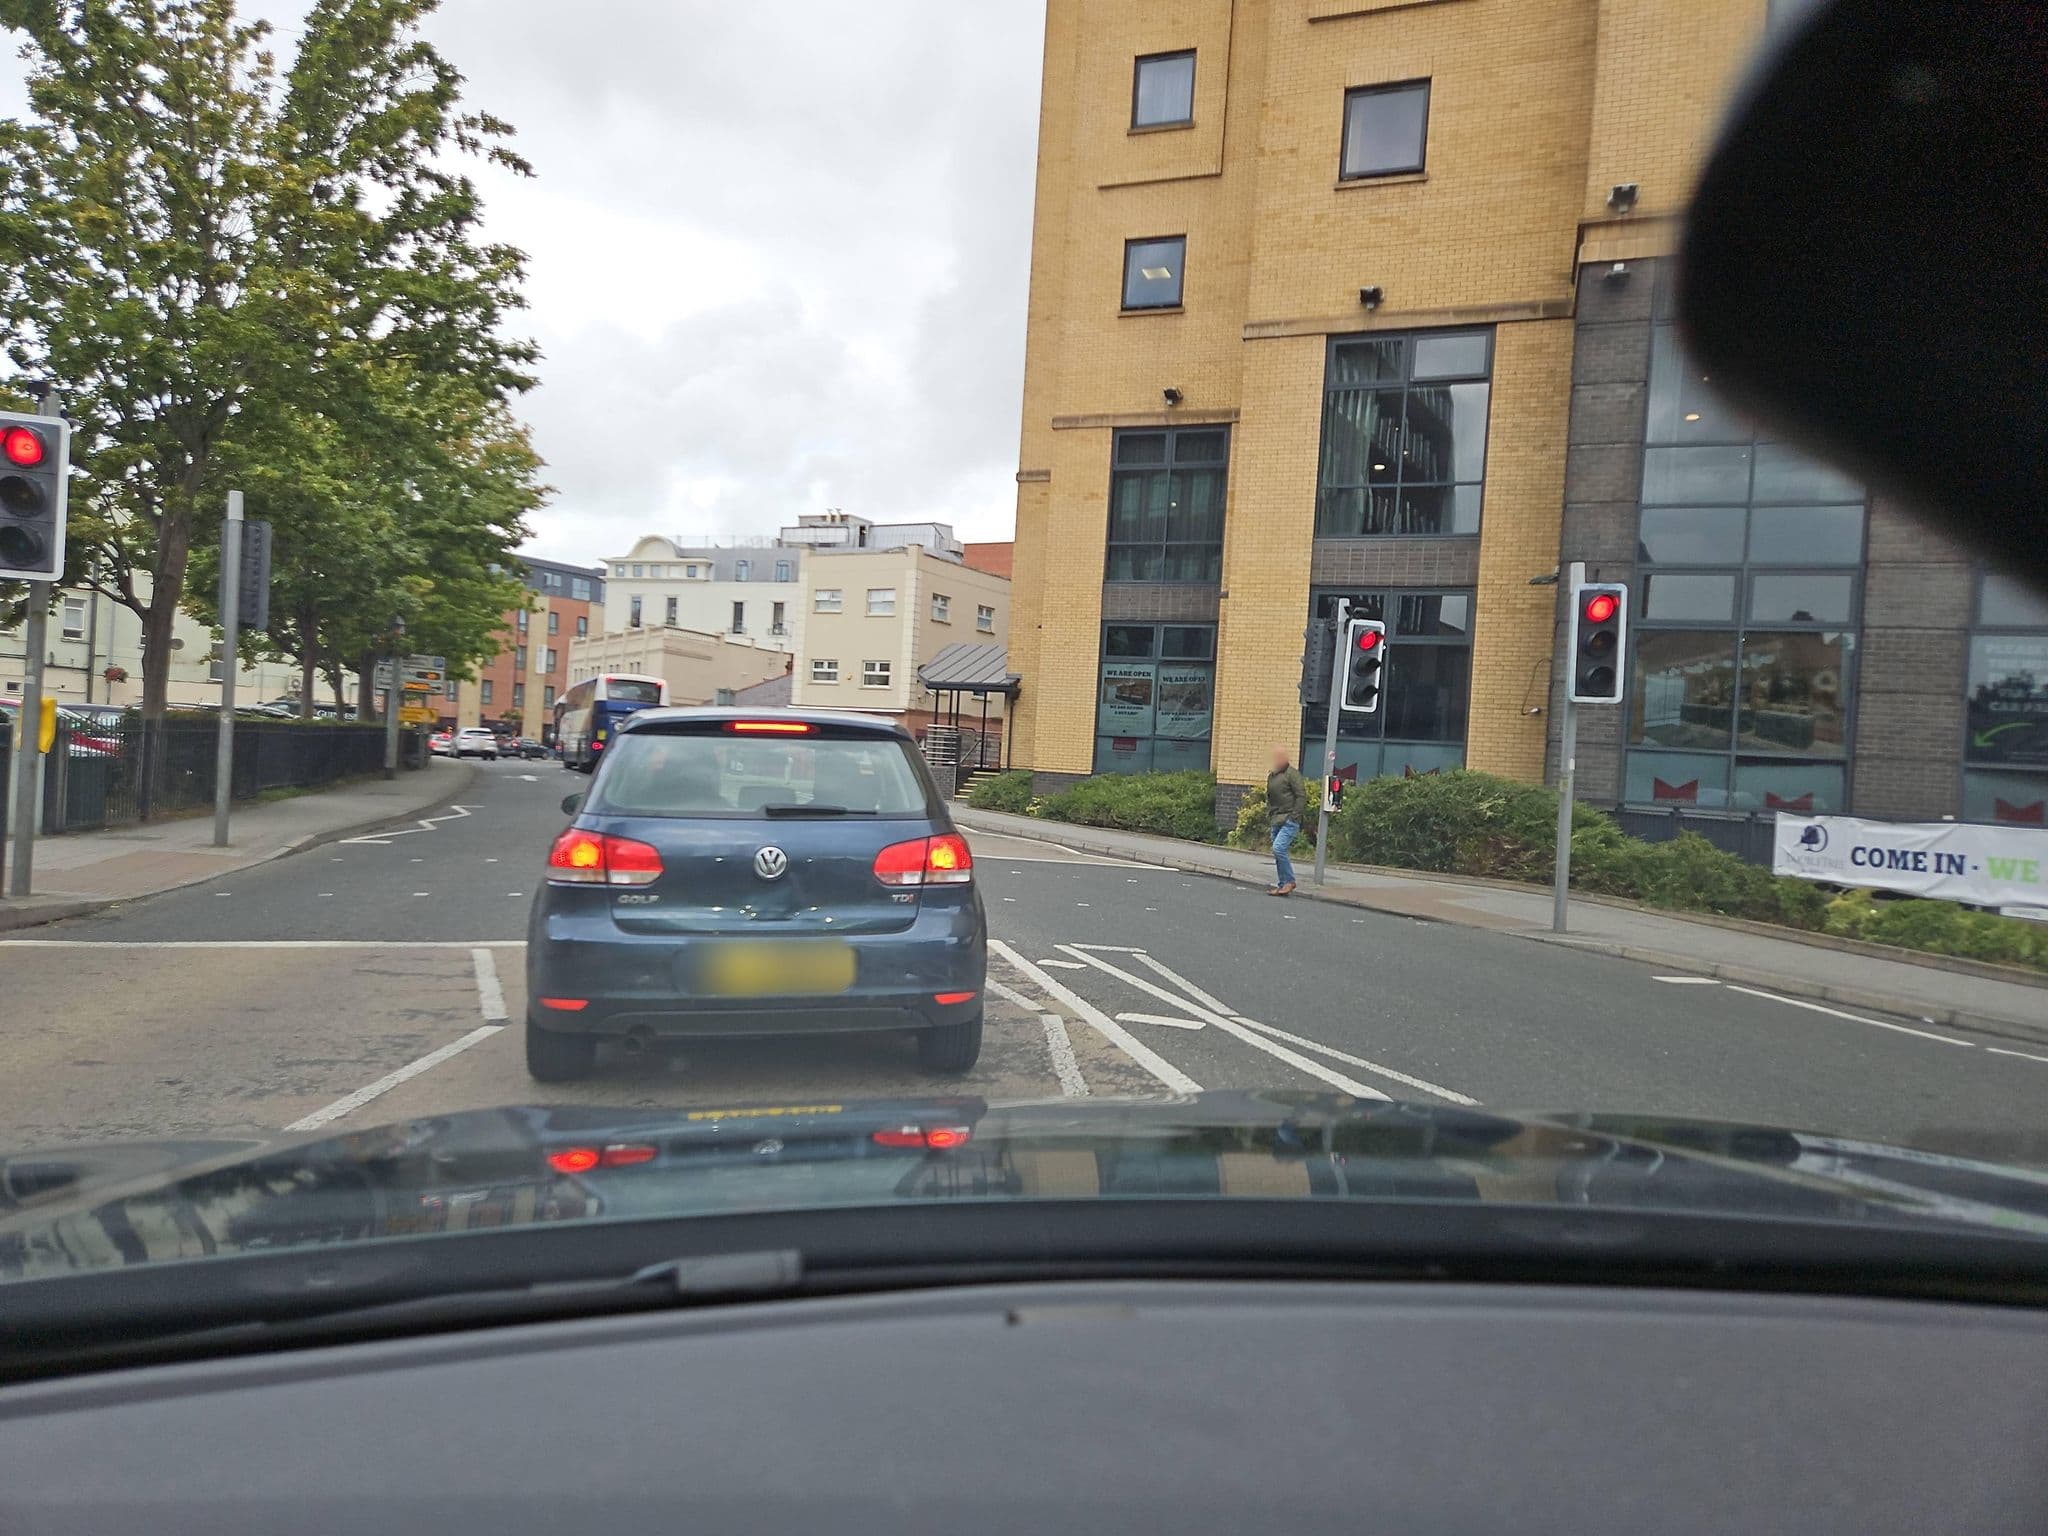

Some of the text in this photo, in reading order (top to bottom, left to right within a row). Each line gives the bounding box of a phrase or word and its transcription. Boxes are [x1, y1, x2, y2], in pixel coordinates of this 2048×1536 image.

[1851, 846, 2041, 884] COME IN WE
[618, 894, 660, 904] GOLF
[891, 894, 914, 903] TDI
